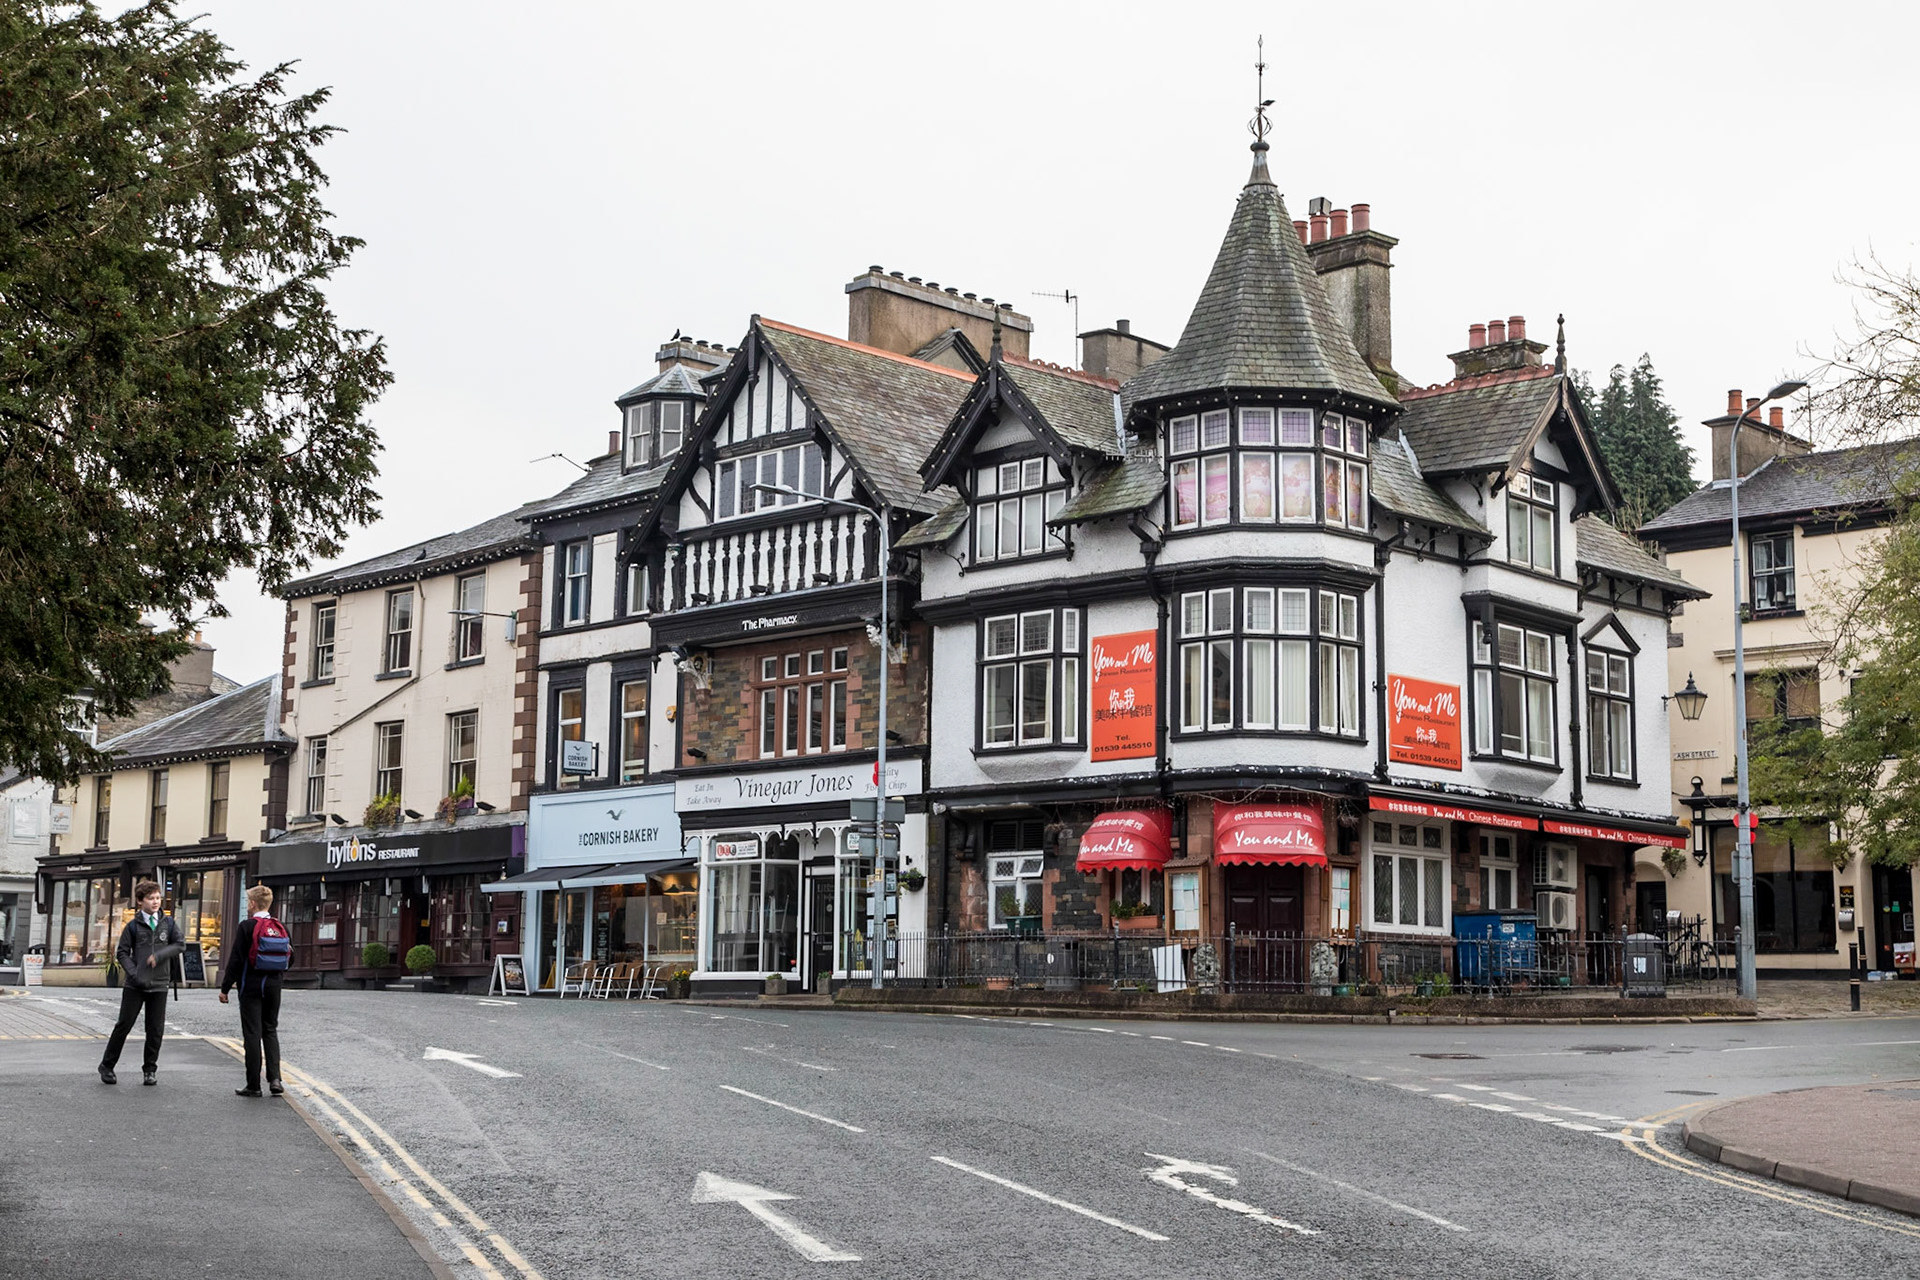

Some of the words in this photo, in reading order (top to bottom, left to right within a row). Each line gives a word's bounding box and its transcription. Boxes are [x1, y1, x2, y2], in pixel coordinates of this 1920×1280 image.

[742, 619, 758, 630] The
[759, 615, 798, 628] Pharmacy
[1094, 644, 1114, 683] You
[1114, 652, 1129, 668] and
[1131, 642, 1154, 666] Me
[1120, 667, 1152, 675] Restaurant
[1394, 679, 1418, 724] You
[1418, 698, 1433, 714] and
[1434, 692, 1457, 717] Me
[1115, 734, 1131, 742] Tel.
[1094, 743, 1120, 752] 01539
[1121, 741, 1152, 750] 445510
[1691, 750, 1715, 758] STREET
[1410, 753, 1432, 762] 01539
[1433, 756, 1458, 766] 445510
[695, 784, 705, 792] Eat
[706, 783, 714, 791] In
[734, 777, 802, 803] Vinegar
[805, 774, 854, 797] Jones
[888, 780, 908, 792] Chips
[687, 796, 701, 806] Take
[702, 795, 722, 806] Away
[1433, 808, 1444, 818] You
[1444, 810, 1456, 819] and
[1456, 809, 1465, 820] Me
[1468, 811, 1492, 824] Chinese
[1492, 816, 1523, 828] Restaurant
[583, 830, 621, 846] CORNISH
[623, 827, 659, 844] BAKERY
[1091, 837, 1115, 853] and
[1116, 836, 1134, 853] Me
[1234, 830, 1260, 847] You
[1263, 830, 1293, 845] and
[1296, 829, 1314, 847] Me
[1597, 829, 1606, 838] You
[1606, 831, 1616, 840] and
[1616, 831, 1624, 841] Me
[1627, 833, 1647, 844] Chinese
[1647, 835, 1674, 847] Restaurant
[326, 838, 377, 869] hyltons
[378, 847, 420, 860] RESTAURANT
